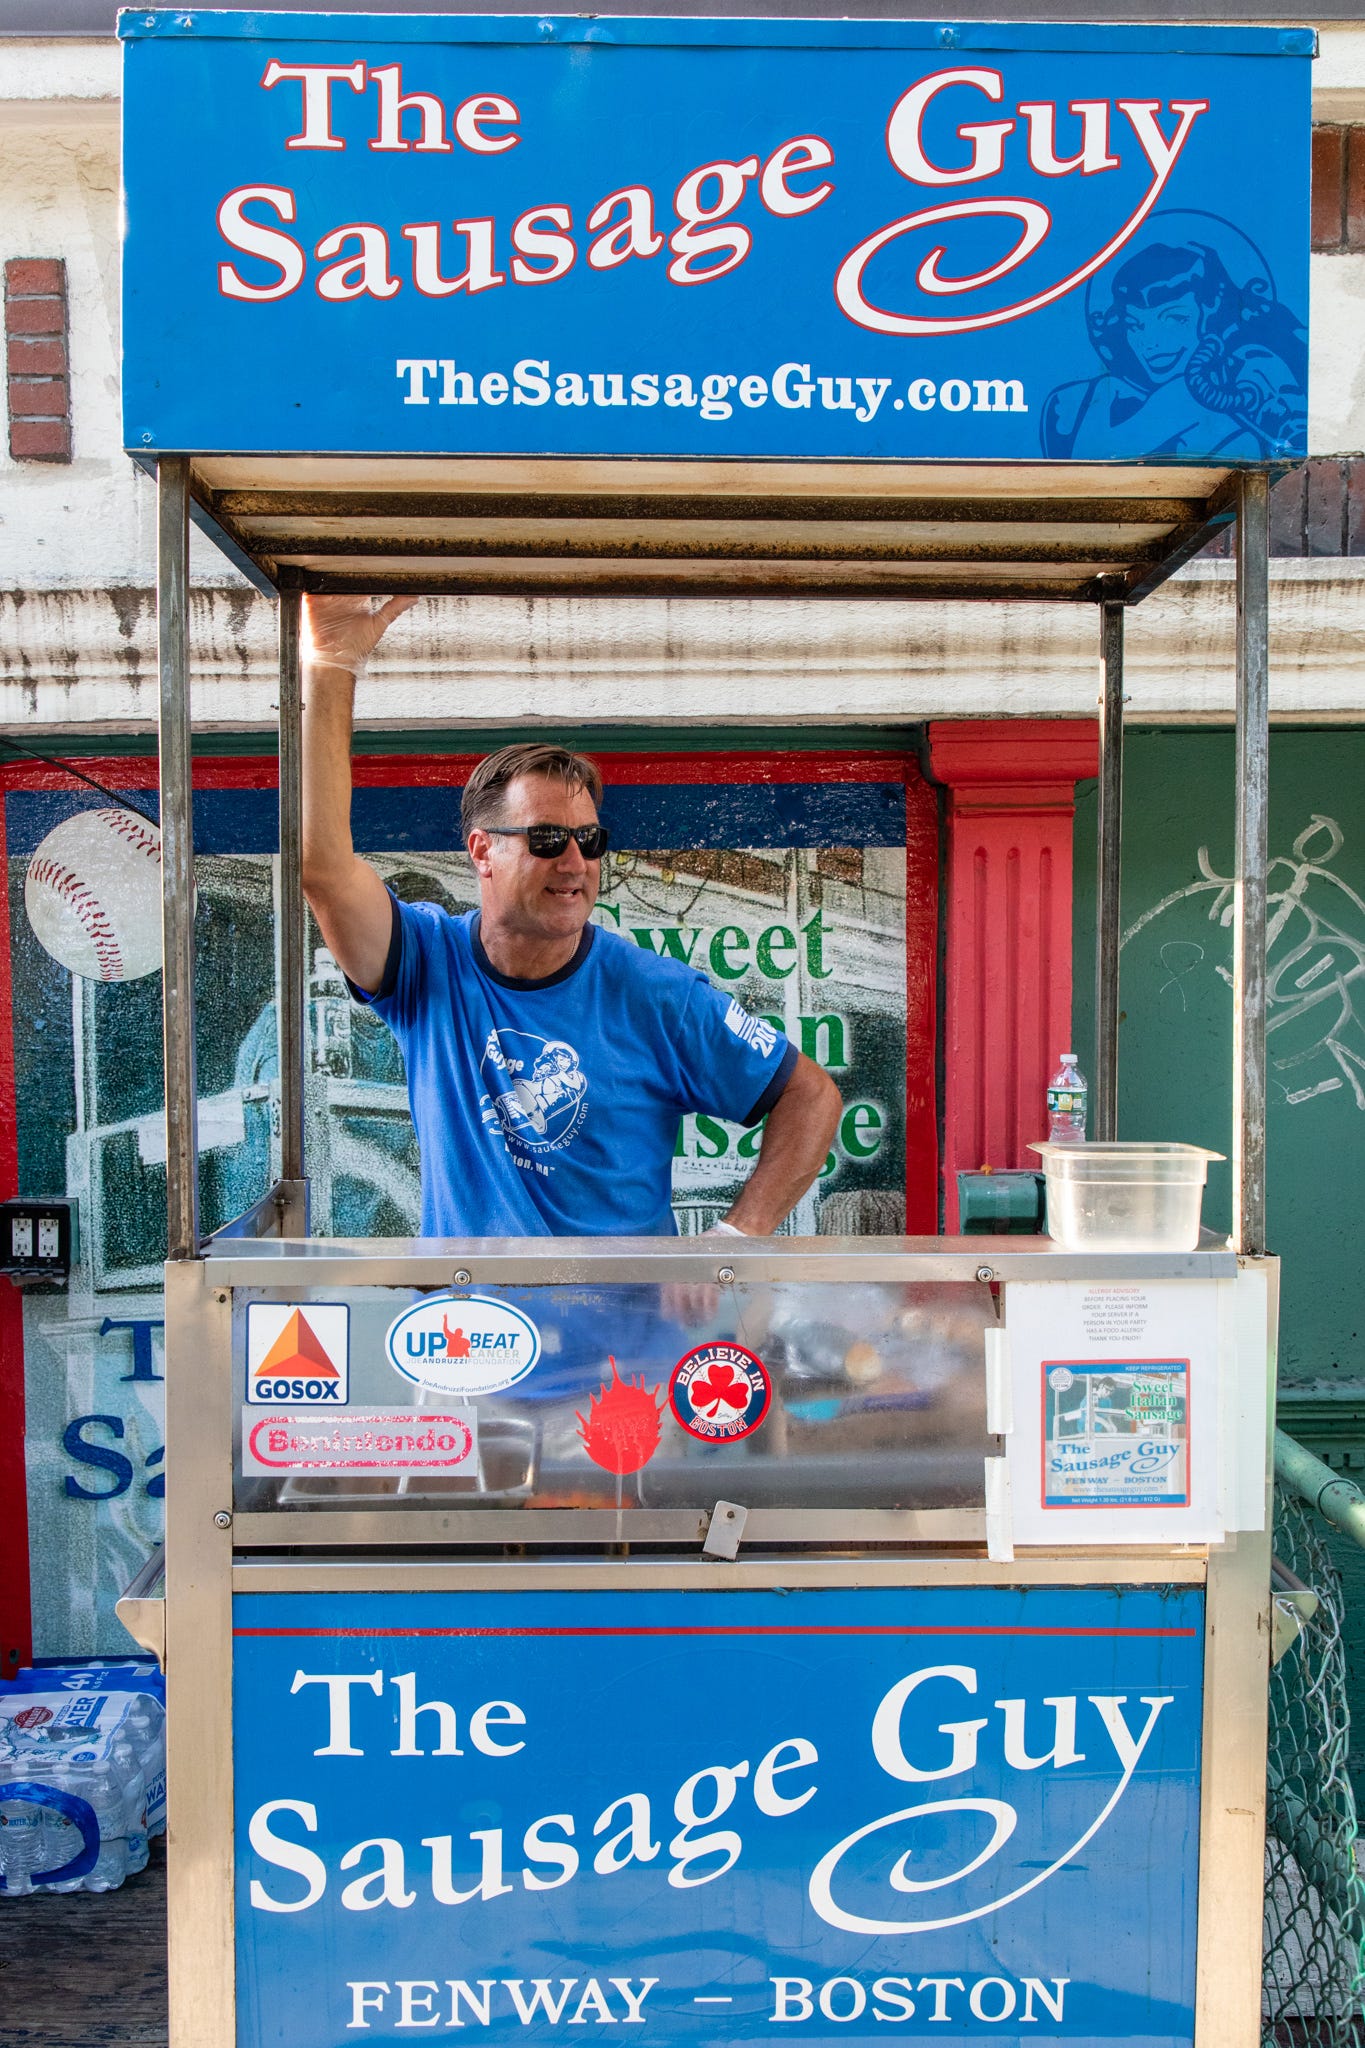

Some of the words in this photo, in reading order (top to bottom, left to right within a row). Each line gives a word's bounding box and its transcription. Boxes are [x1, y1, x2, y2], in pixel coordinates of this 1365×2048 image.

[260, 58, 522, 154] The
[216, 134, 834, 303] Sausage
[834, 66, 1209, 336] Guy
[396, 359, 1029, 422] TheSausageGuy.com
[406, 1332, 447, 1357] UP
[470, 1333, 520, 1349] BEAT
[470, 1350, 519, 1358] CANCER
[676, 1347, 753, 1386] BELIEVE
[749, 1371, 765, 1392] IN
[255, 1380, 340, 1399] GOSOX
[421, 1378, 510, 1392] JoeAndruzziFoundation.org
[1133, 1381, 1173, 1393] Sweet
[1131, 1394, 1177, 1406] Italian
[688, 1415, 748, 1437] BOSTON
[1125, 1409, 1182, 1424] Sausage
[1050, 1450, 1131, 1473] Sausage
[1129, 1441, 1180, 1474] Guy
[1058, 1444, 1091, 1455] The
[1124, 1476, 1168, 1484] BOSTON
[64, 1697, 97, 1726] ATER
[289, 1669, 527, 1757] The
[248, 1738, 819, 1913] Sausage
[808, 1665, 1174, 1935] Guy
[346, 1977, 660, 2028] FENWAY
[768, 1977, 1071, 2023] BOSTON
